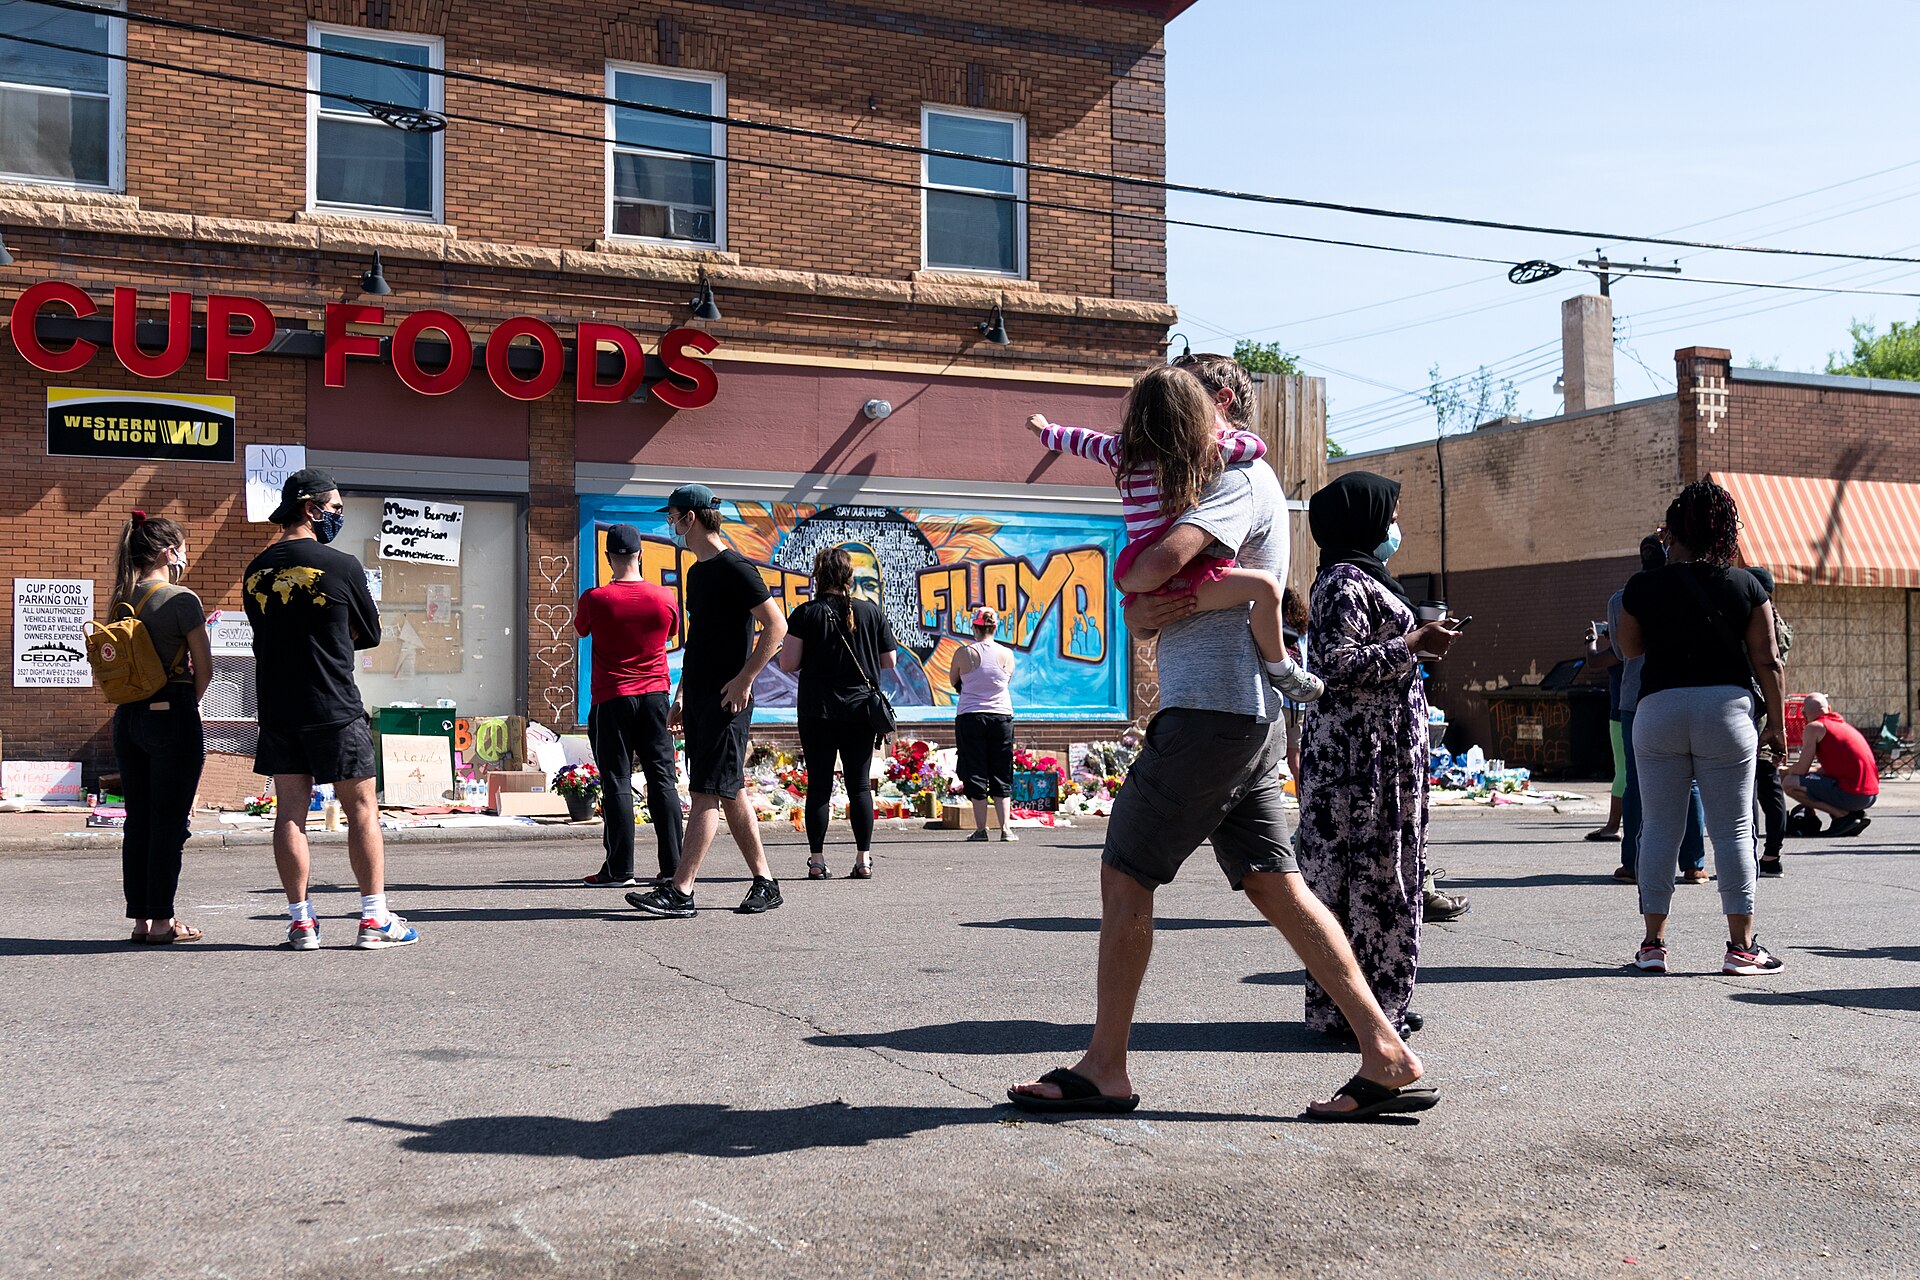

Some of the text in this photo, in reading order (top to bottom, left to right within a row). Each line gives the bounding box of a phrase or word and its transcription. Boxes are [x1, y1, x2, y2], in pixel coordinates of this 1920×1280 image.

[11, 280, 720, 410] CUP FOODS
[63, 415, 156, 430] WESTERN
[93, 429, 156, 443] UNION
[167, 420, 219, 446] WU
[261, 447, 287, 469] NO
[247, 469, 297, 485] JUSTI
[835, 507, 850, 516] SAY
[850, 507, 866, 517] OUR
[381, 519, 448, 540] Conviction
[809, 520, 843, 530] TERRENCE
[821, 527, 839, 536] RICE
[885, 530, 911, 538] CASTILE
[26, 583, 82, 594] CUP FOODS
[19, 595, 88, 606] PARKING ONLY
[917, 547, 1107, 664] FLOYD
[36, 607, 86, 615] UNAUTHORIZED
[57, 616, 72, 624] WILL
[74, 616, 82, 624] BE
[24, 624, 84, 632] TOWED AT VEHICLE
[24, 632, 52, 640] OWNERS
[218, 628, 254, 640] SWA
[21, 654, 80, 662] CEDAR
[1499, 735, 1571, 764] GEORGE
[28, 762, 76, 771] JUSTICE
[7, 773, 53, 783] NO PEACE
[408, 766, 426, 783] 4
